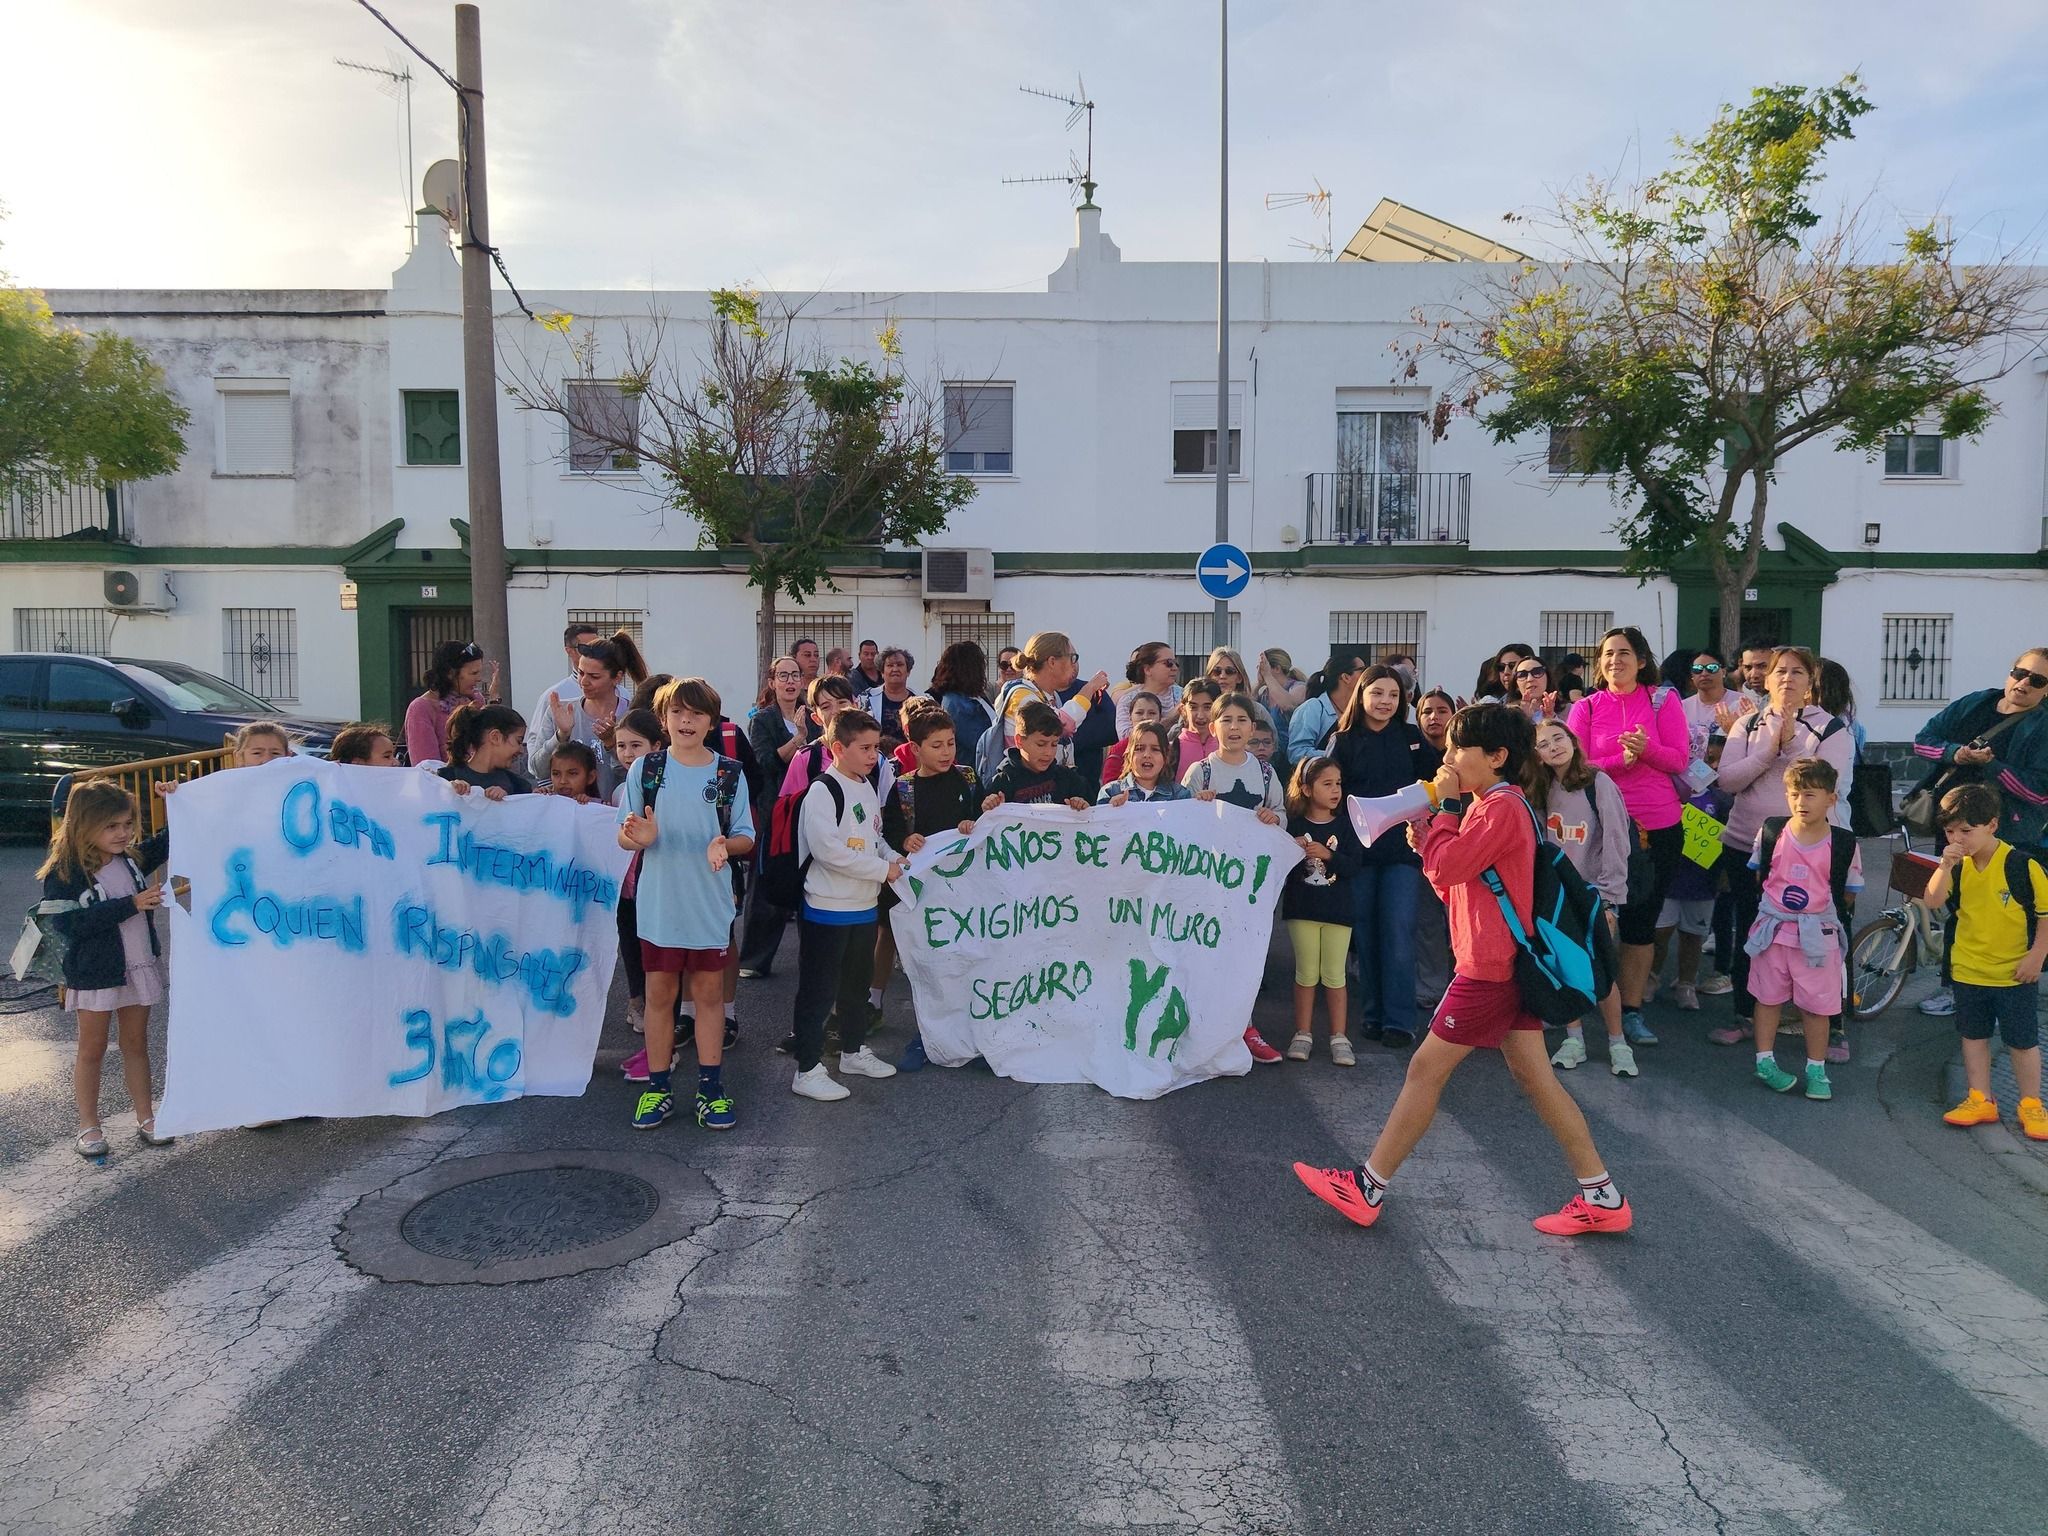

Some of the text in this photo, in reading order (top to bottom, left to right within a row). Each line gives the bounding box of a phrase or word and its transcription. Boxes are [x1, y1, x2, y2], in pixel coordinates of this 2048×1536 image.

[423, 587, 435, 597] 51
[1746, 590, 1757, 600] 55
[1684, 806, 1720, 836] URO
[985, 822, 1063, 872] AÑOS
[1074, 831, 1110, 868] DE
[924, 895, 1222, 949] EXIGIMOS UN MURO
[969, 958, 1190, 1063] SEGURO YA
[391, 1010, 436, 1086] 3
